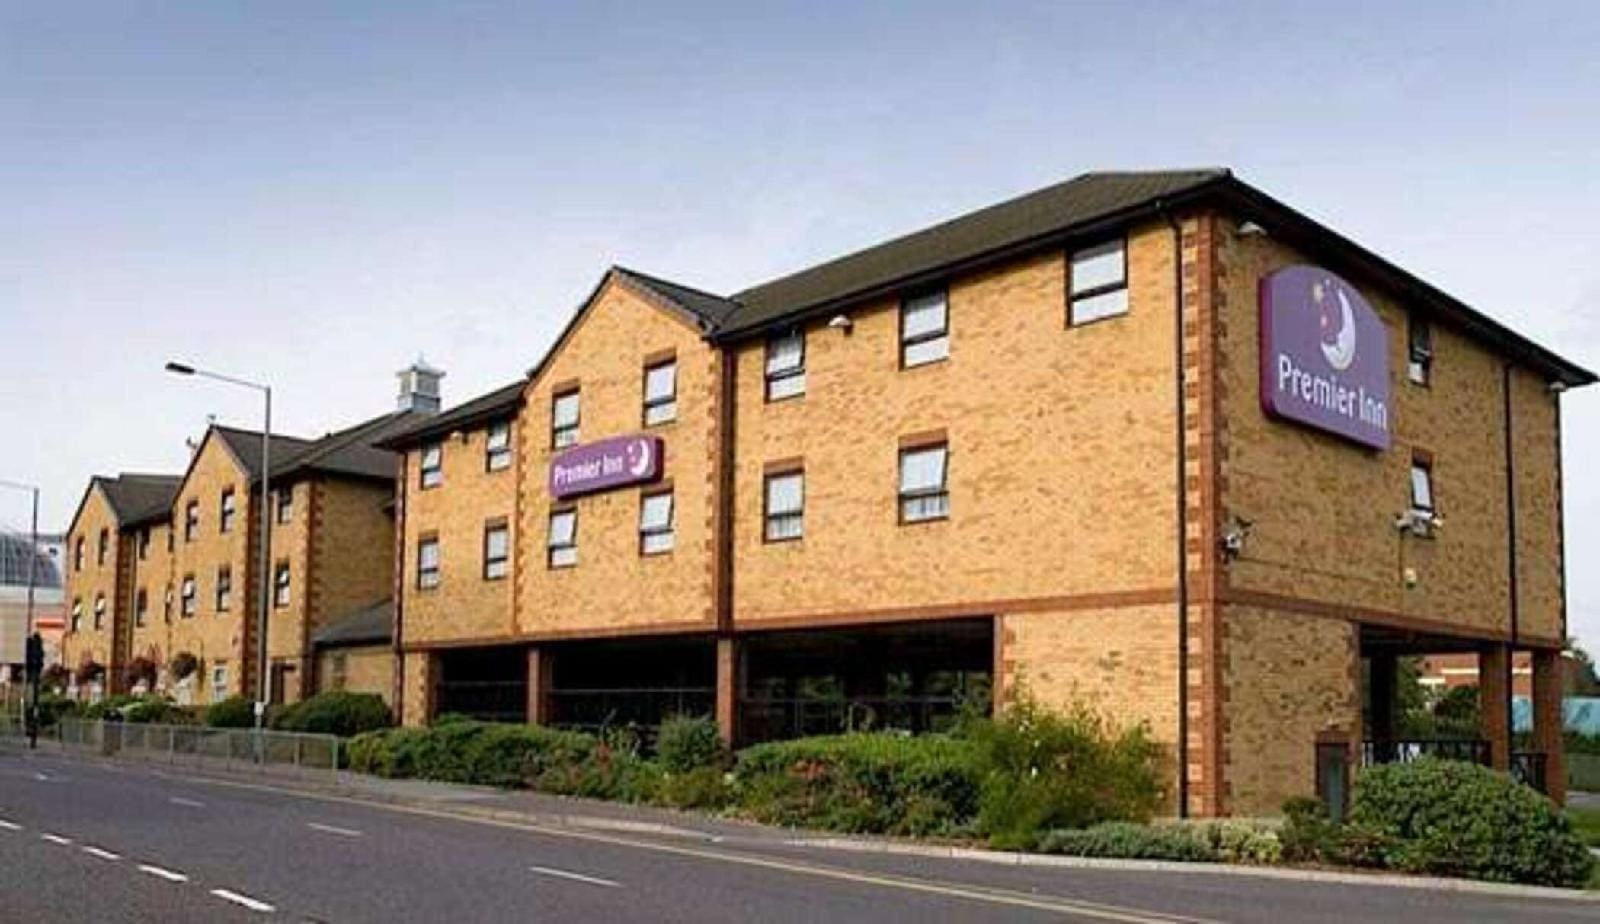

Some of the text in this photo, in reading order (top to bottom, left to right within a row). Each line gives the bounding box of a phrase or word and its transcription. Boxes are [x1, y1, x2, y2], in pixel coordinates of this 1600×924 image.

[1278, 353, 1387, 430] Premier Inn
[554, 453, 623, 488] Premier Inn
